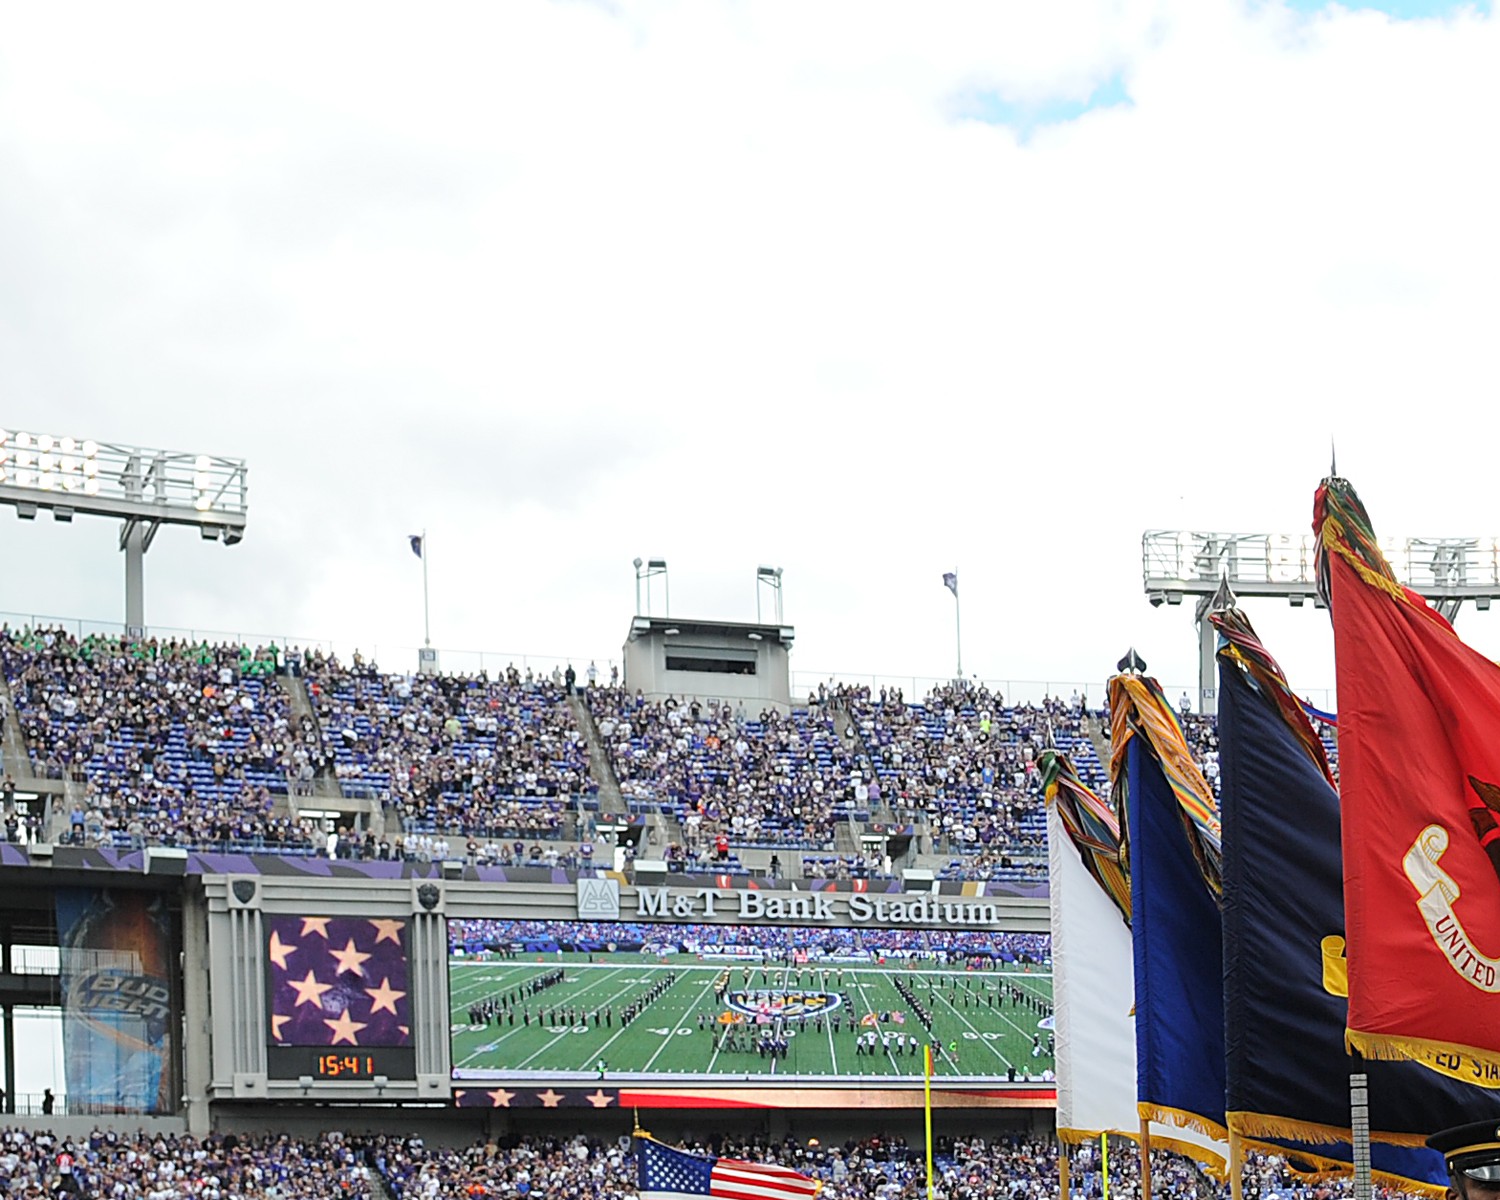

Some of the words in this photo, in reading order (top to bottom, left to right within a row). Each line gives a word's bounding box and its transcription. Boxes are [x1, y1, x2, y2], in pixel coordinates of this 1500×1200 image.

[635, 886, 723, 918] M&T
[738, 889, 837, 921] Bank
[849, 892, 1002, 926] Stadium
[1434, 914, 1496, 988] UNITED
[91, 974, 169, 1003] BUD
[79, 989, 171, 1019] LIGHT
[318, 1054, 374, 1076] 15:41
